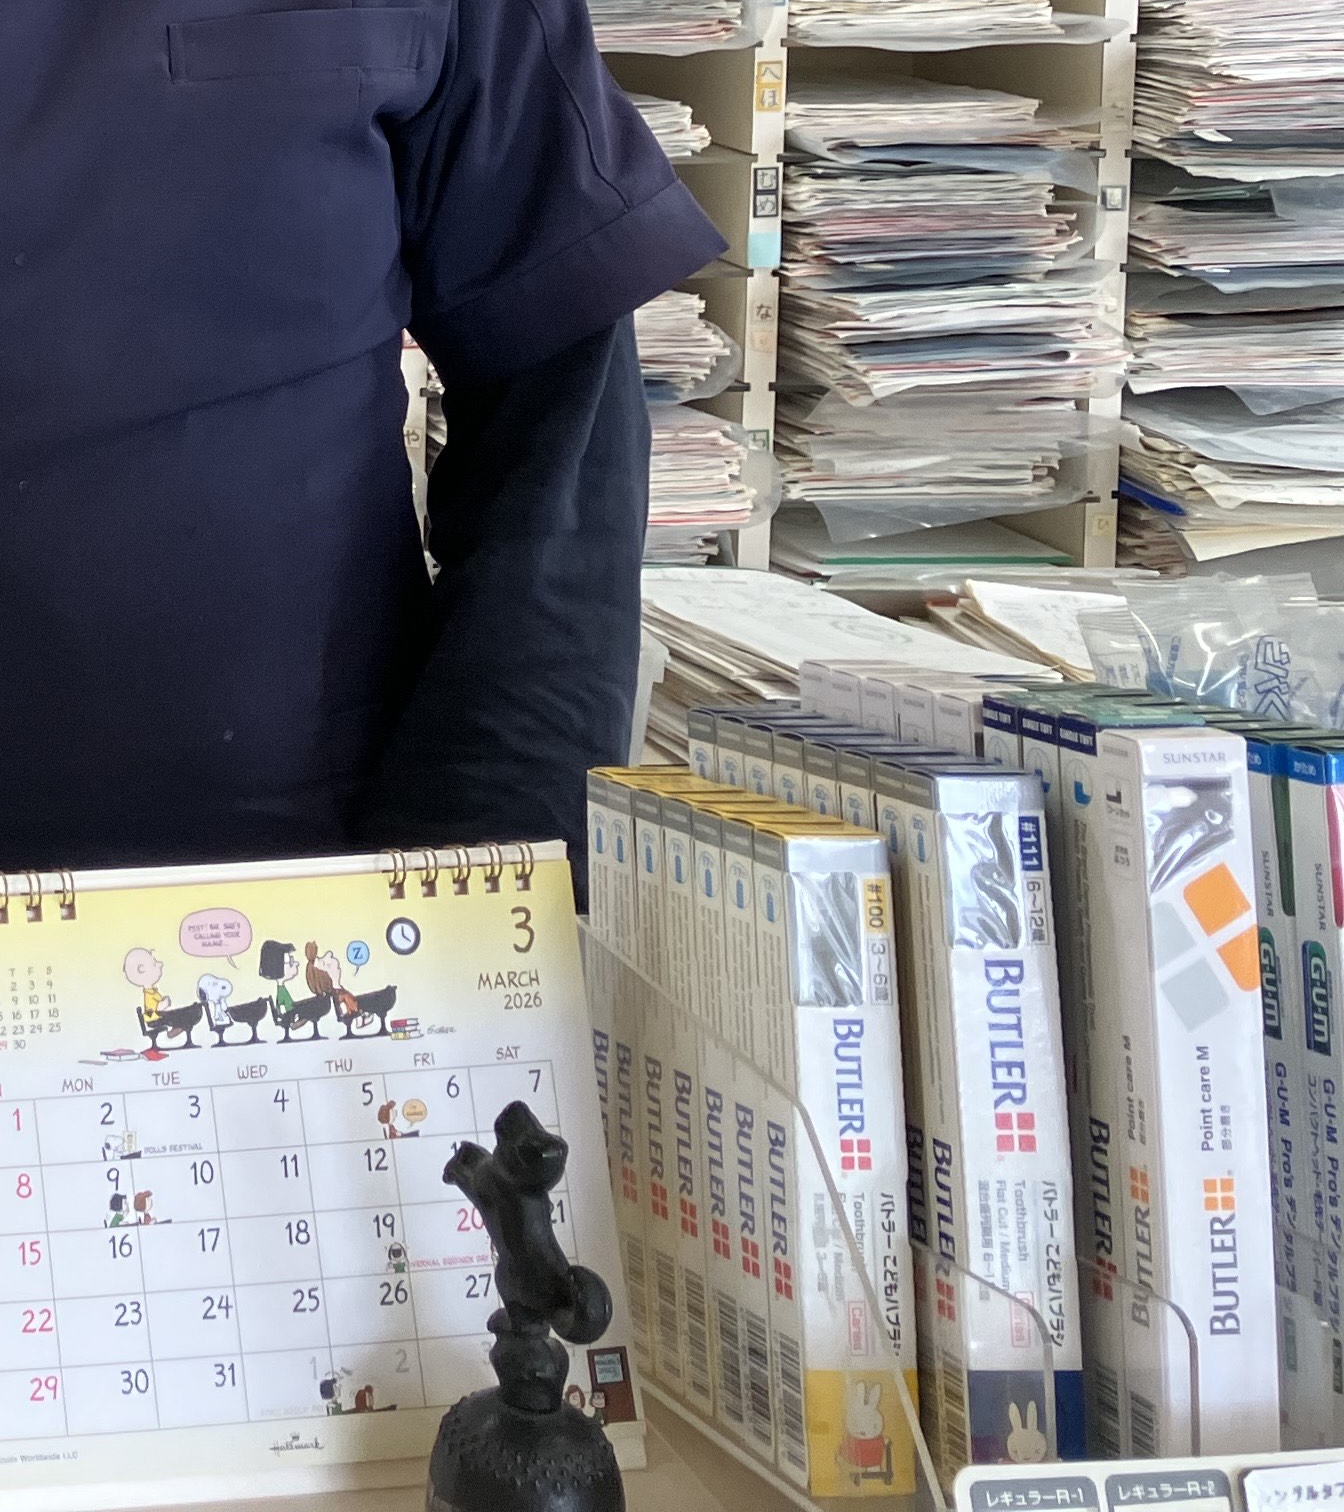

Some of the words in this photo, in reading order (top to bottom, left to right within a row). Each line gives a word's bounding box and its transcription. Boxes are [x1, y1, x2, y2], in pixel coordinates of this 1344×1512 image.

[1163, 751, 1226, 765] SUNSTAR
[1020, 821, 1040, 868] #111
[867, 883, 884, 929] #100
[1262, 850, 1274, 917] SUNSTAR
[1315, 863, 1326, 932] SUNSTAR
[353, 947, 363, 960] Z
[511, 906, 535, 953] 3
[10, 982, 17, 991] 2
[29, 980, 35, 990] 3
[47, 979, 53, 989] 4
[12, 995, 18, 1005] 9
[29, 995, 39, 1005] 10
[48, 994, 56, 1003] 11
[477, 969, 540, 991] MARCH
[504, 991, 543, 1010] 2026
[12, 1010, 22, 1020] 16
[30, 1009, 40, 1019] 17
[48, 1008, 59, 1018] 18
[12, 1025, 25, 1035] 23
[30, 1024, 42, 1034] 24
[49, 1022, 61, 1033] 25
[984, 959, 1027, 1110] BUTLER
[13, 1039, 26, 1050] 30
[62, 1077, 94, 1094] MON
[152, 1071, 180, 1086] TUE
[237, 1064, 268, 1080] WED
[324, 1058, 353, 1074] THU
[413, 1052, 435, 1067] FRI
[496, 1046, 520, 1061] SAT
[1196, 1045, 1209, 1061] M
[12, 1108, 22, 1132] 1
[100, 1102, 115, 1125] 2
[188, 1095, 201, 1118] 3
[273, 1089, 289, 1112] 4
[361, 1081, 374, 1106] 5
[446, 1075, 460, 1098] 6
[529, 1069, 541, 1093] 7
[616, 1041, 634, 1163] BUTLER
[832, 1018, 866, 1137] BUTLER
[1200, 1066, 1210, 1102] care
[645, 1053, 663, 1180] BUTLER
[674, 1068, 693, 1197] BUTLER
[1200, 1106, 1214, 1152] Point
[16, 1173, 33, 1199] 8
[106, 1167, 120, 1192] 9
[190, 1160, 214, 1186] 10
[280, 1153, 300, 1178] 11
[364, 1147, 389, 1173] 12
[705, 1086, 726, 1217] BUTLER
[734, 1101, 756, 1236] BUTLER
[767, 1120, 788, 1256] BUTLER
[1042, 1180, 1058, 1238] バトラー
[1089, 1116, 1113, 1257] BUTLER
[18, 1240, 42, 1266] 15
[108, 1233, 133, 1259] 16
[197, 1227, 221, 1253] 17
[285, 1219, 311, 1246] 18
[372, 1212, 396, 1238] 19
[456, 1207, 486, 1232] 20
[880, 1192, 895, 1249] バトラー
[1014, 1180, 1027, 1261] Toothbrush
[1209, 1212, 1241, 1336] BUTLER
[21, 1308, 54, 1334] 22
[114, 1301, 143, 1327] 23
[202, 1294, 233, 1320] 24
[292, 1287, 320, 1313] 25
[379, 1280, 409, 1306] 26
[465, 1273, 492, 1299] 27
[30, 1376, 59, 1402] 29
[120, 1368, 150, 1396] 30
[214, 1362, 237, 1388] 31
[309, 1356, 318, 1380] 1
[394, 1349, 410, 1374] 2
